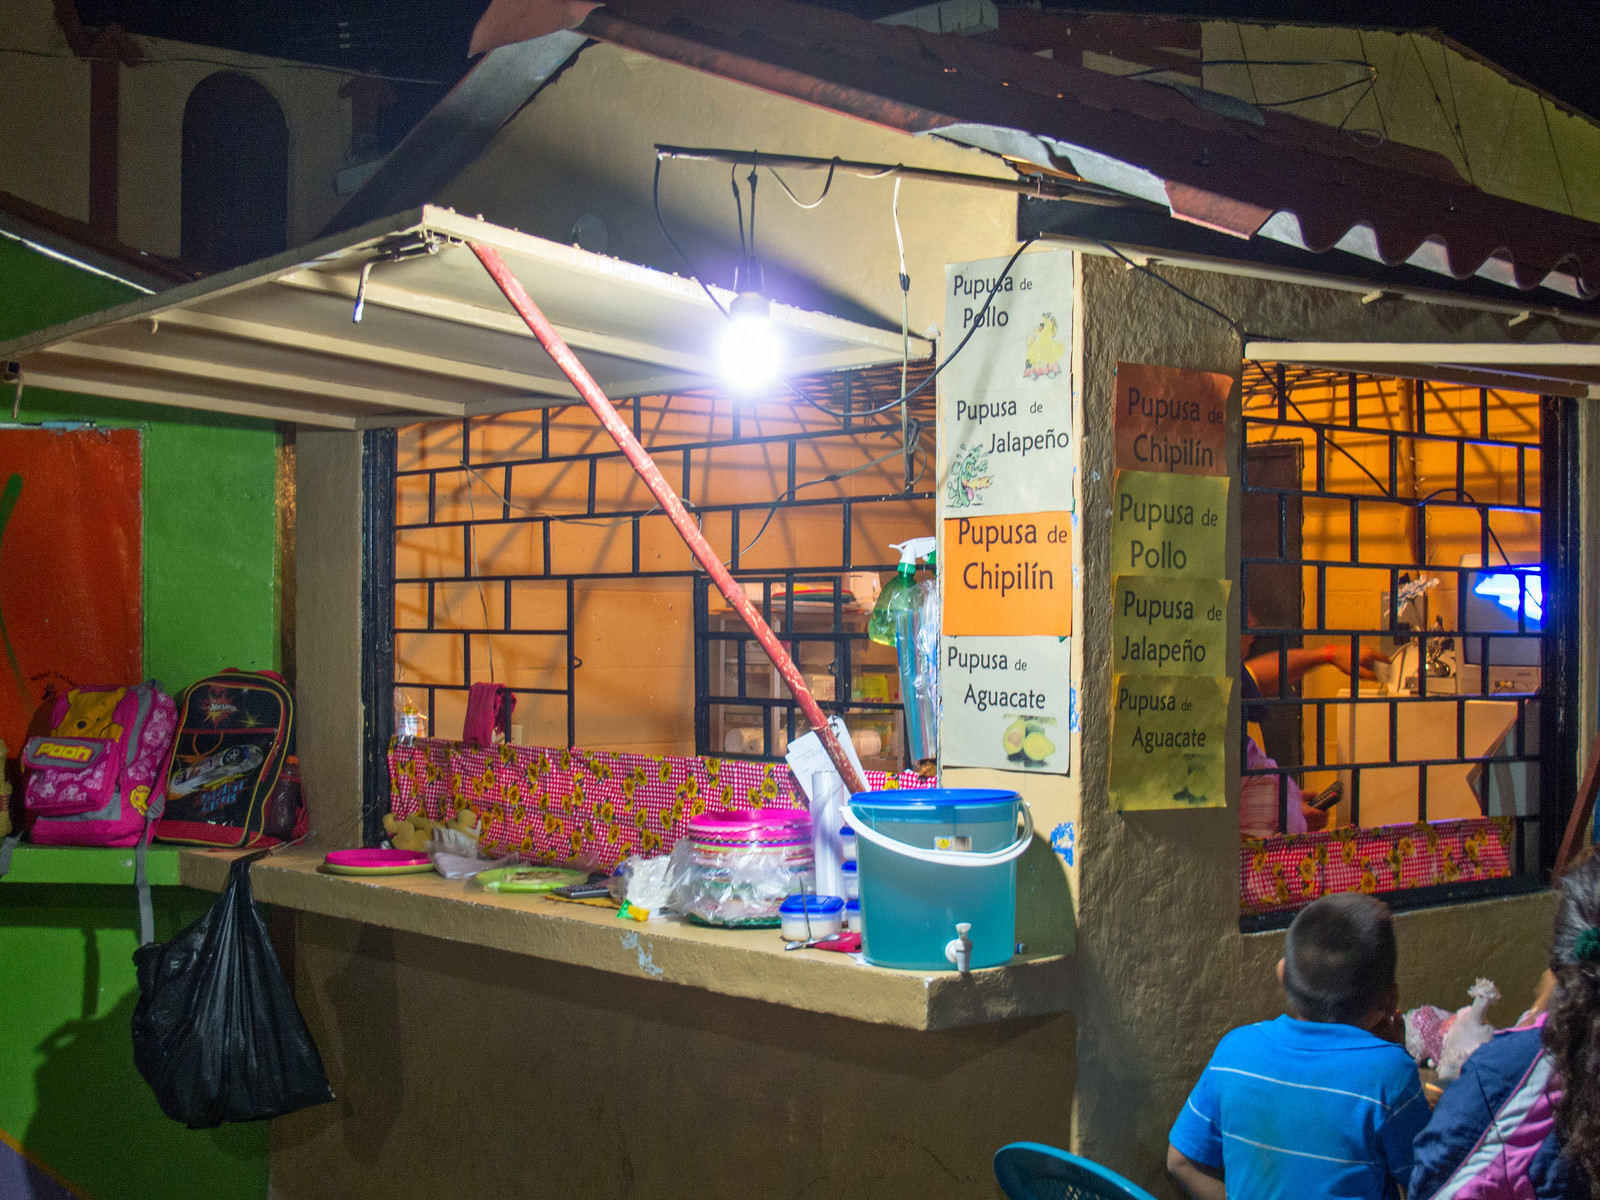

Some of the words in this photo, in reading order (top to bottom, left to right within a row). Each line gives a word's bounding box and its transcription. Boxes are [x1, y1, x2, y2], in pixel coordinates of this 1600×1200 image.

[1020, 278, 1033, 290] de
[963, 306, 1009, 328] Pollo
[957, 400, 1017, 424] Pupusa
[1029, 401, 1043, 414] de
[1128, 387, 1200, 425] Pupusa
[1207, 406, 1224, 424] de
[988, 429, 1070, 456] Jalapeño
[1133, 434, 1213, 472] Chipilín
[1119, 493, 1194, 530] Pupusa
[1201, 508, 1218, 527] de
[958, 518, 1037, 552] Pupusa
[1047, 525, 1068, 543] de
[1131, 540, 1187, 570] Pollo
[963, 562, 1054, 597] Chipilín
[1123, 590, 1194, 625] Pupusa
[1207, 605, 1222, 621] de
[947, 646, 1008, 673] Pupusa
[1014, 658, 1027, 671] de
[1121, 635, 1206, 668] Jalapeño
[963, 684, 1046, 711] Aguacate
[1119, 688, 1176, 716] Pupusa
[1181, 696, 1192, 711] de
[1131, 726, 1206, 753] Aguacate
